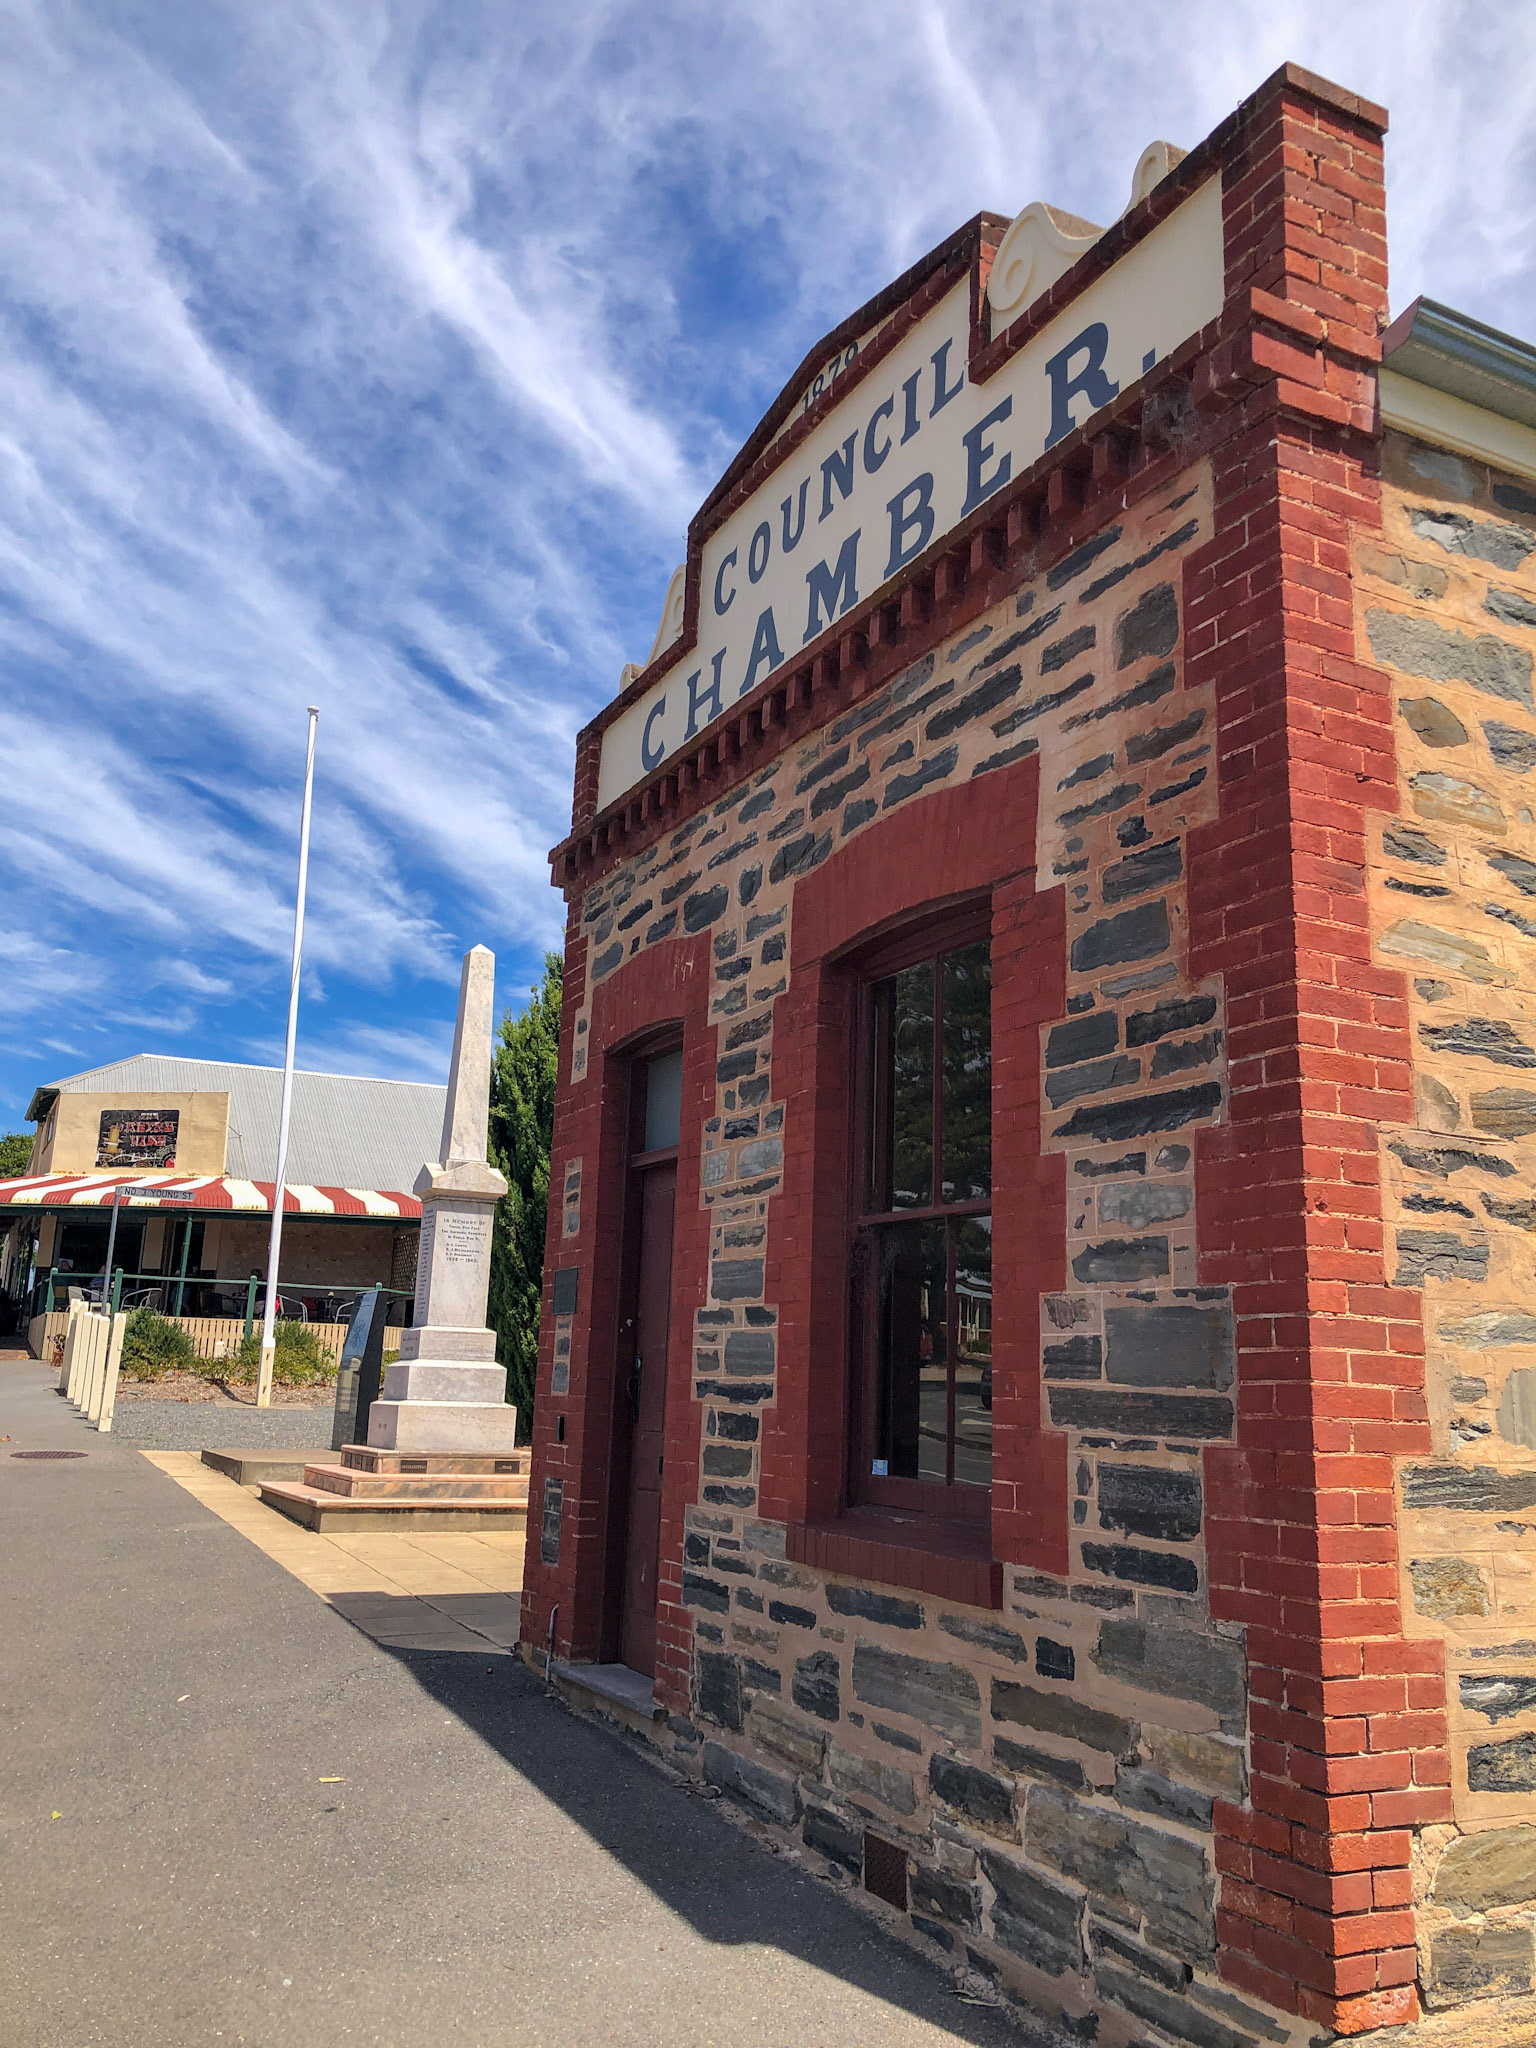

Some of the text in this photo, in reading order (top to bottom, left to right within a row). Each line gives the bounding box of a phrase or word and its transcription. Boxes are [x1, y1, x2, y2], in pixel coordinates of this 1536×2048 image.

[713, 336, 965, 616] COUNCIL
[141, 1188, 147, 1197] 3
[151, 1189, 179, 1199] YOUNG
[182, 1191, 193, 1200] ST
